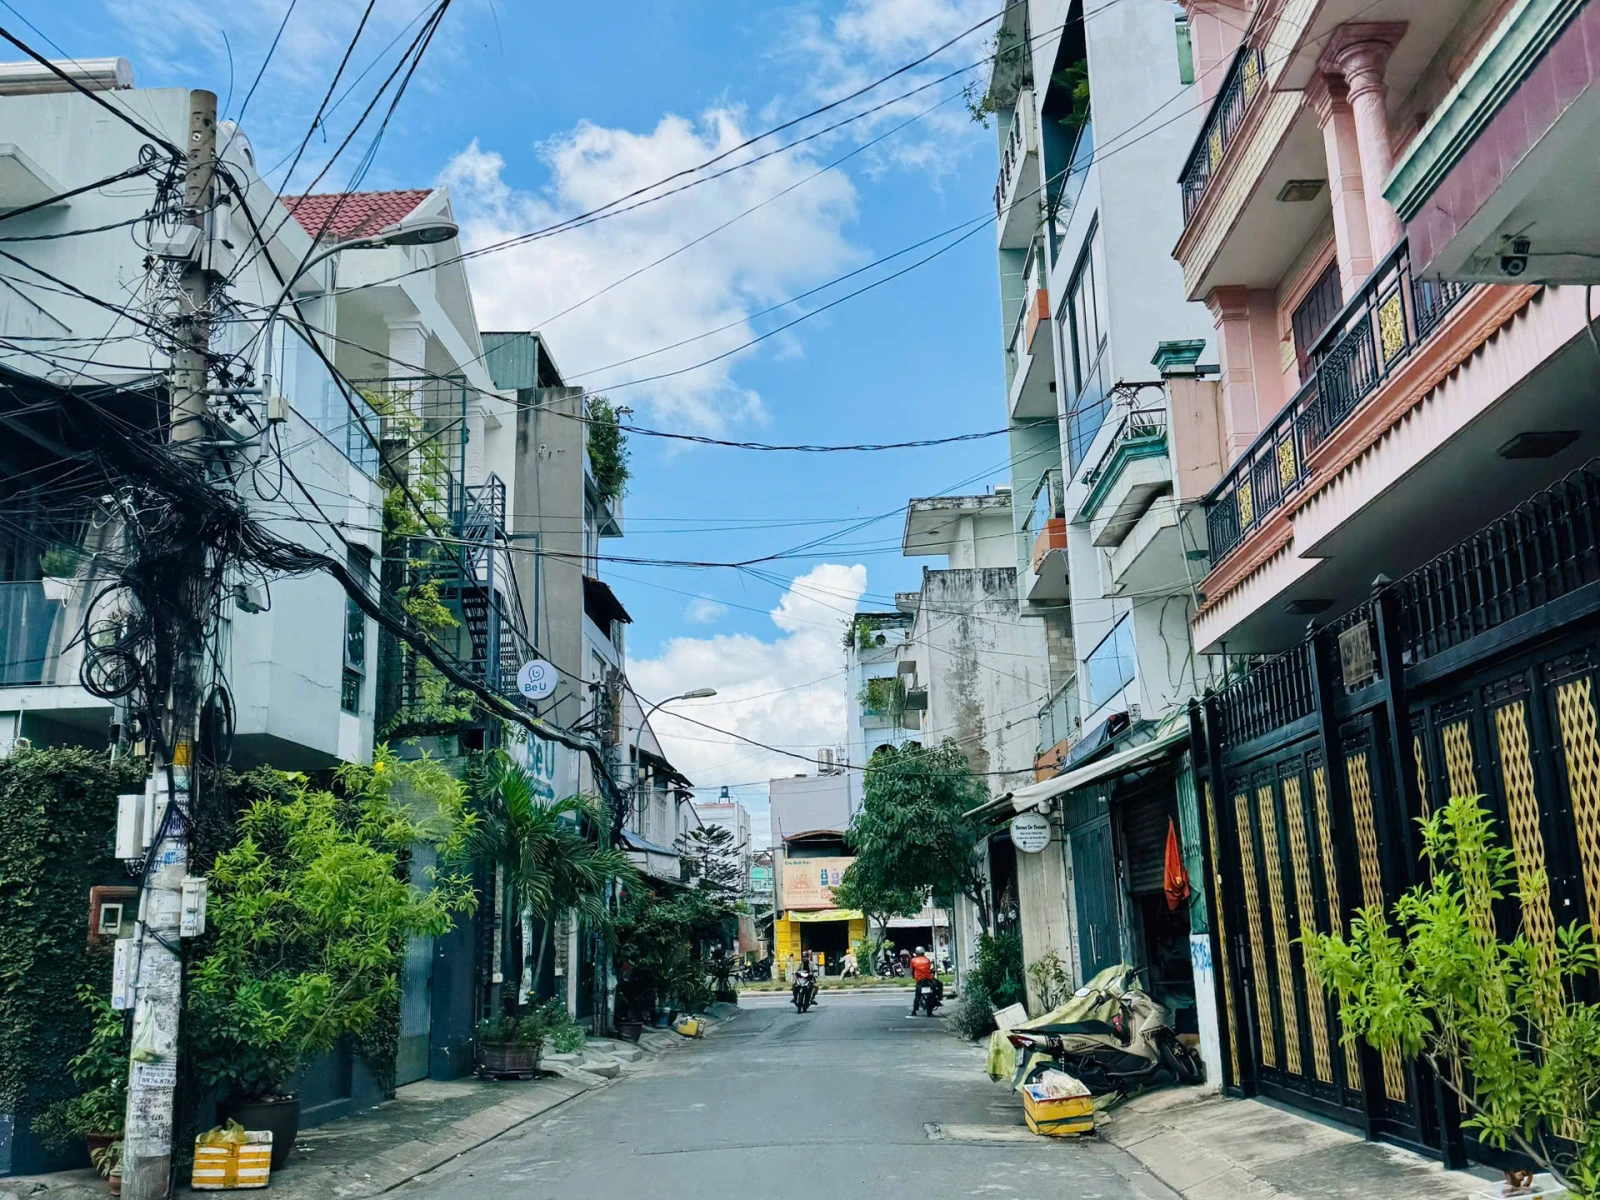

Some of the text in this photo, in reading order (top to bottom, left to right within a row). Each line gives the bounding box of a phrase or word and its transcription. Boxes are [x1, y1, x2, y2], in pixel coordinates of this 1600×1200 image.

[524, 682, 547, 692] Be U
[526, 731, 555, 780] Be U
